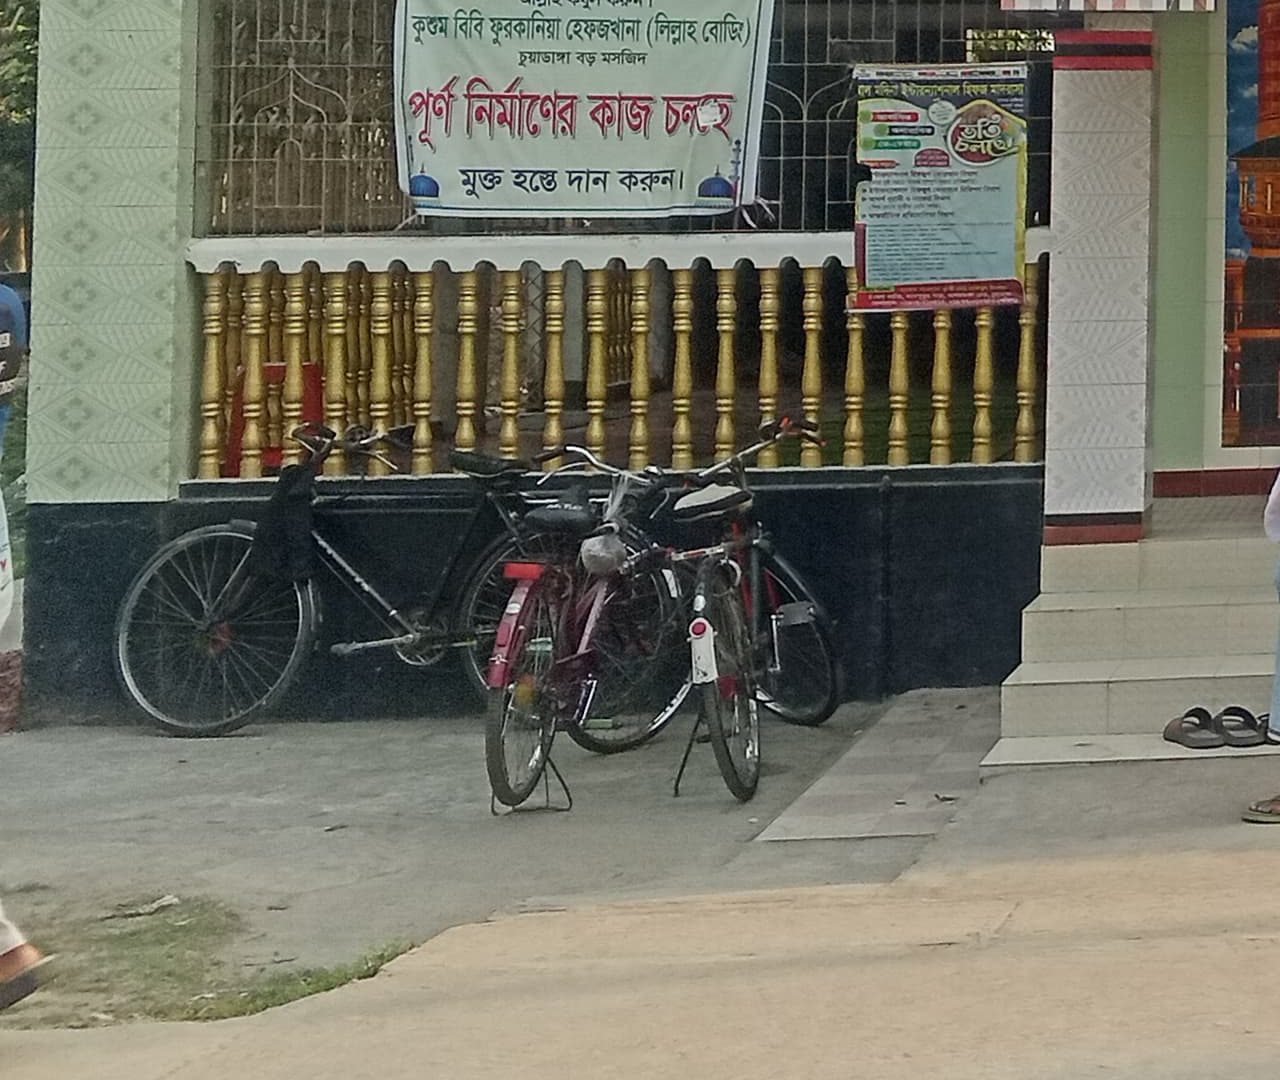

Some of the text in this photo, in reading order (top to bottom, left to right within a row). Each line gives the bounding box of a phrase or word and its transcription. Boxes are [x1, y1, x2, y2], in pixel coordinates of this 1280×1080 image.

[453, 9, 485, 39] বিবি
[489, 10, 562, 46] ফুরকানিয়া
[566, 17, 642, 42] হেফজখানা
[518, 48, 648, 67] চুয়াডাঙ্গা বড় মসজিদ
[408, 75, 460, 153] পূর্ণ
[463, 76, 579, 140] নির্মাণের
[587, 90, 654, 140] কাজ
[958, 114, 1002, 139] ভর্তি
[459, 168, 684, 199] মুক্ত হস্তে দান করুন।
